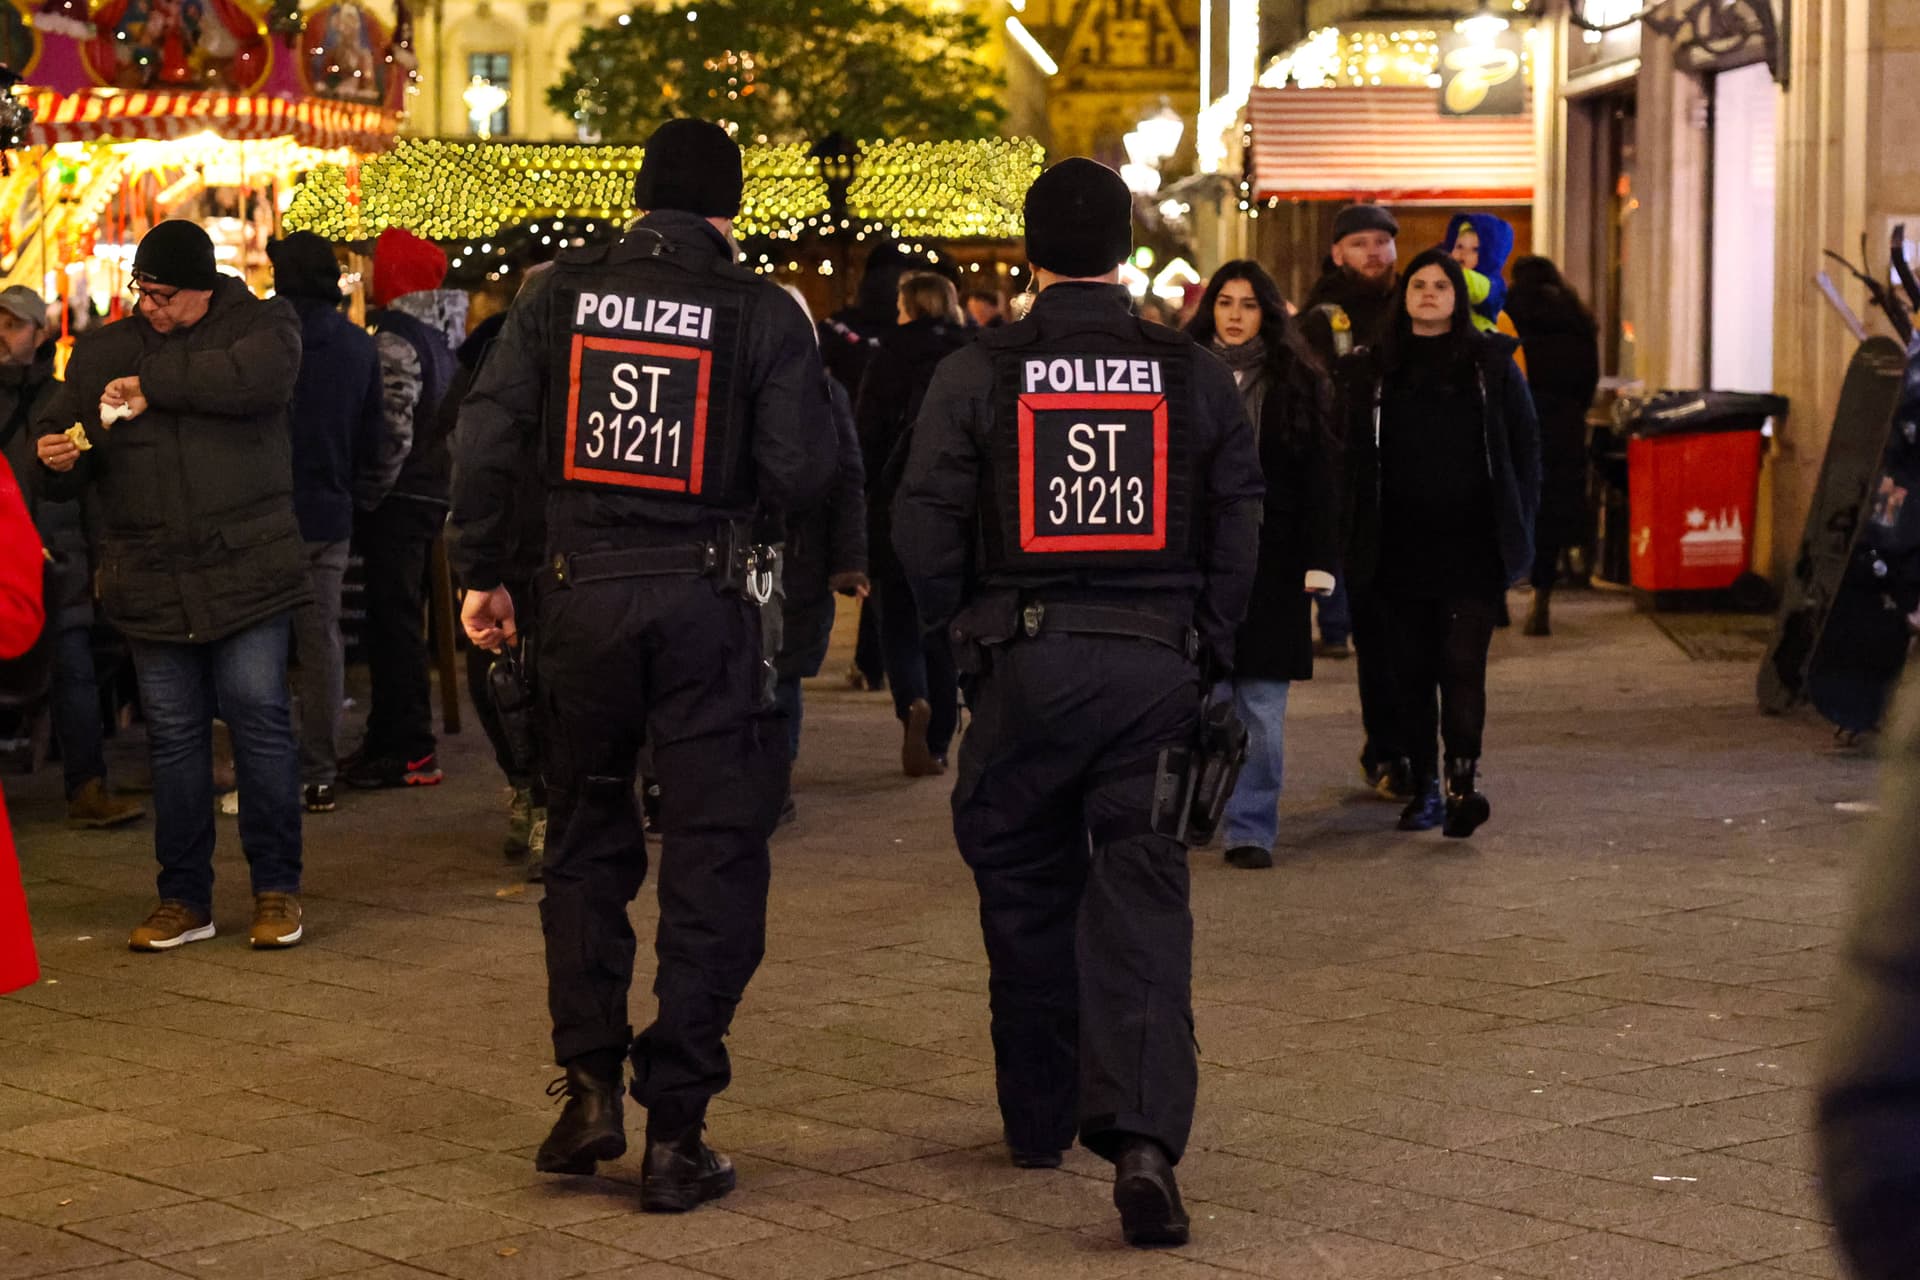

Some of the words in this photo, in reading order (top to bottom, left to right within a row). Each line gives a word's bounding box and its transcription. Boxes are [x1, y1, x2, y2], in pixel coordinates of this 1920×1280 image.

[576, 292, 713, 340] POLIZEI
[609, 362, 671, 414] ST
[1025, 358, 1162, 393] POLIZEI
[585, 411, 681, 467] 31211
[1067, 423, 1127, 473] ST
[1049, 476, 1144, 525] 31213
